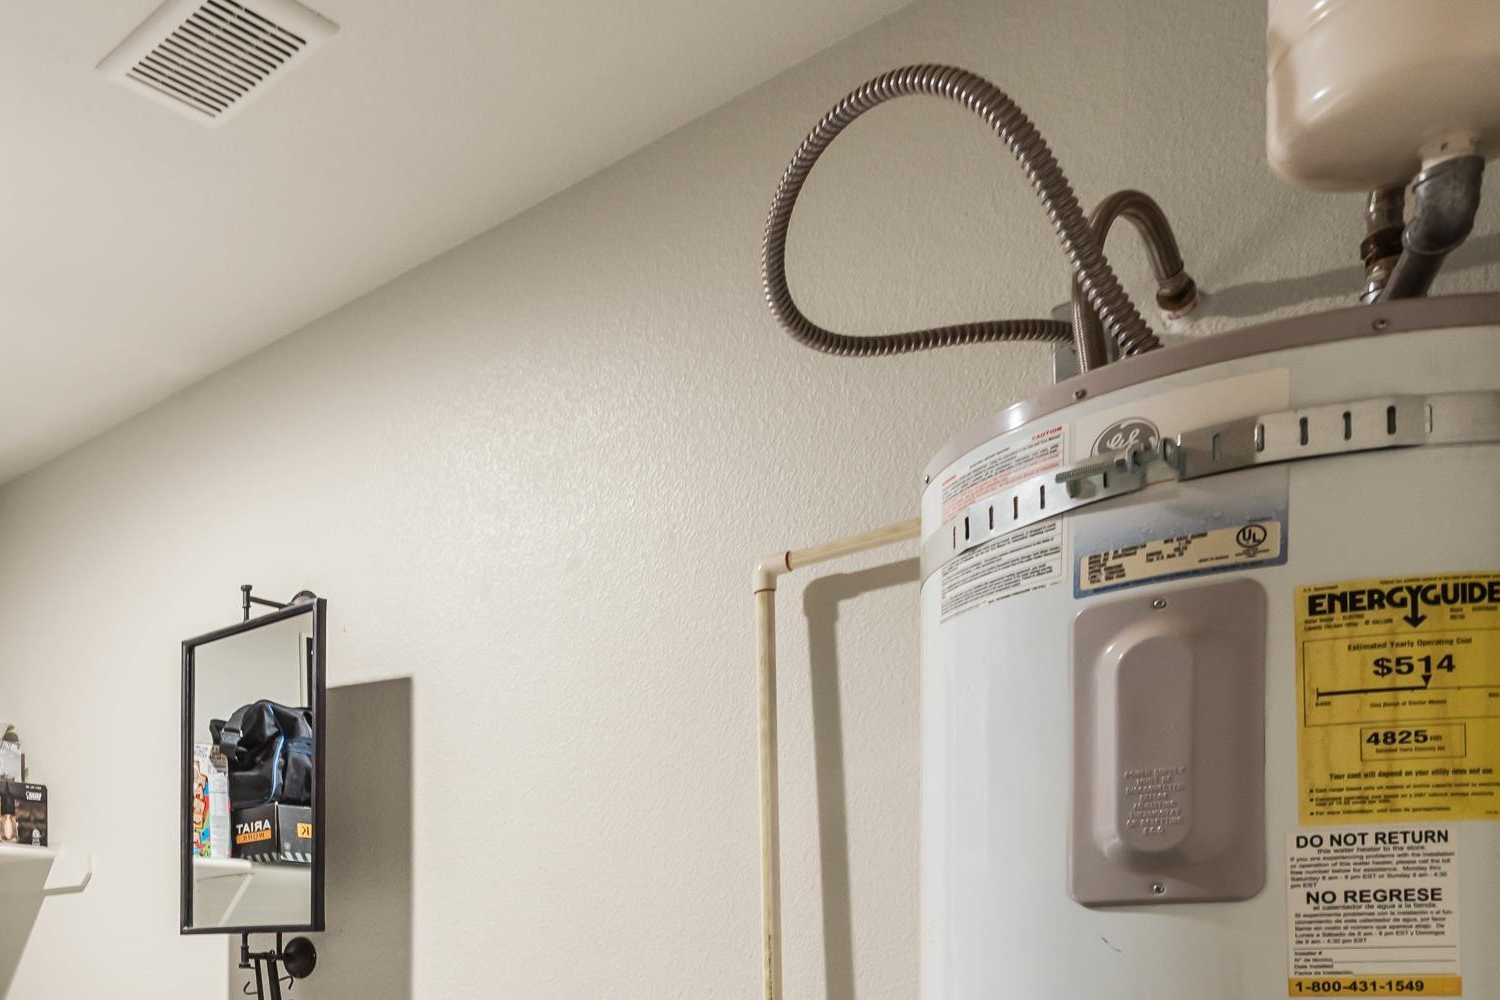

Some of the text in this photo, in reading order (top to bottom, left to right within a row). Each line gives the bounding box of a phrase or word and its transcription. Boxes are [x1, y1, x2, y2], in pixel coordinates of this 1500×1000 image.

[1308, 581, 1500, 617] ENERGYGUIDE
[1348, 637, 1472, 651] Estimated Yearly Operating Cost
[1372, 654, 1456, 678] $514
[1366, 729, 1429, 746] 4825
[1378, 770, 1403, 779] depend
[1415, 770, 1429, 778] your
[1296, 829, 1449, 849] DO NOT RETURN
[1306, 887, 1443, 905] NO REGRESE
[1295, 980, 1425, 993] 1-800-431-1549
